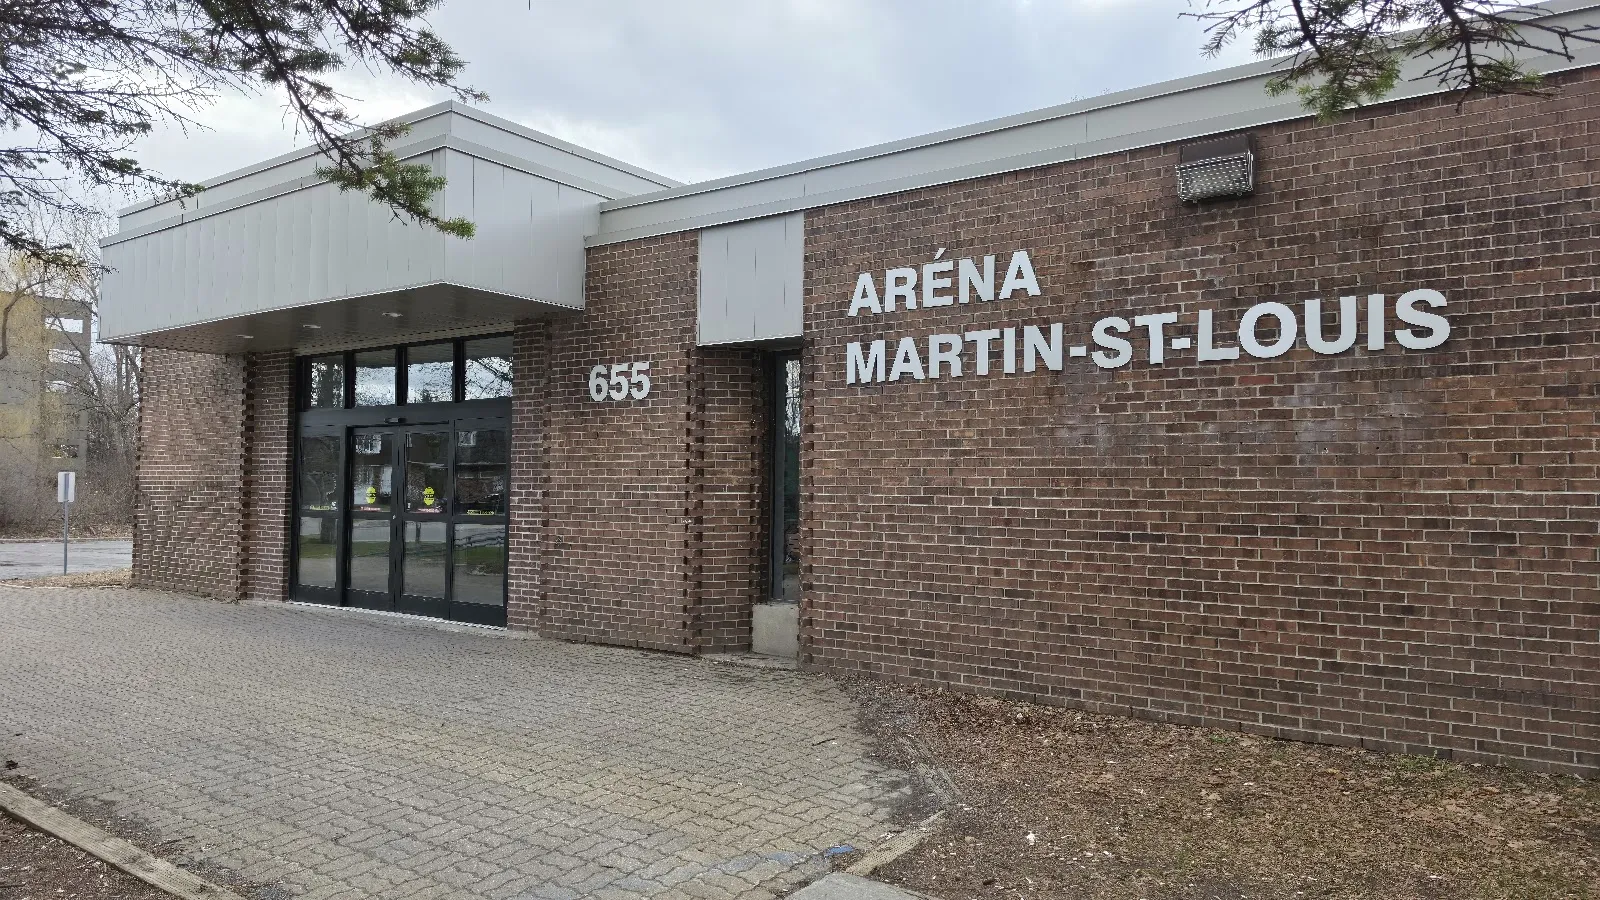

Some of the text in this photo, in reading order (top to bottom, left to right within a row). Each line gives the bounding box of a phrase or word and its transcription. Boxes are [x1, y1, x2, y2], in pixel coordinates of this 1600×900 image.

[847, 247, 1041, 317] ARÉNA
[845, 288, 1451, 386] MARTIN-ST-LOUIS
[588, 361, 651, 402] 655
